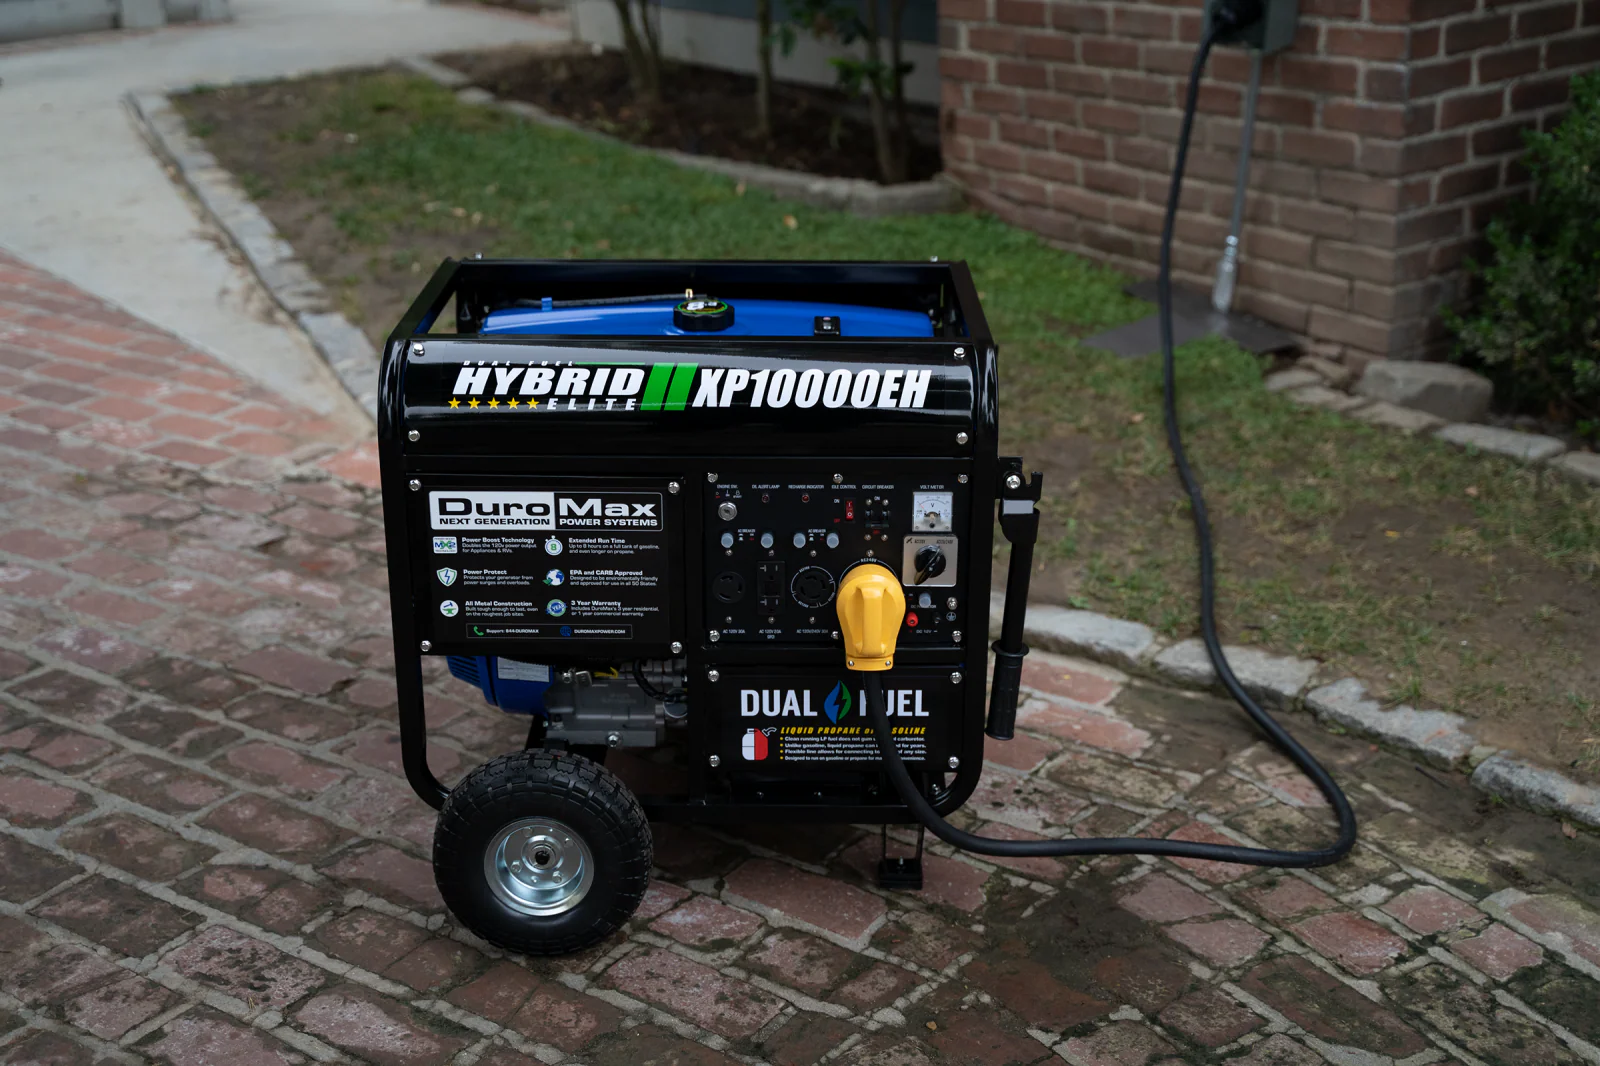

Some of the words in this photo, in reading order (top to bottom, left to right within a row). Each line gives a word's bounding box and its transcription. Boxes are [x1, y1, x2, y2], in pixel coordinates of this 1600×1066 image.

[452, 367, 645, 396] HYBRID
[691, 368, 932, 409] XP10000EH
[546, 397, 637, 411] ELITE
[438, 497, 550, 517] Duro
[558, 497, 656, 517] Max
[439, 518, 470, 526] NEXT
[474, 518, 550, 526] GENERATION
[559, 518, 600, 526] POWER
[603, 518, 658, 526] SYSTEMS
[740, 689, 818, 716] DUAL
[780, 726, 815, 735] LIQUID
[817, 726, 861, 735] PROPANE
[891, 726, 926, 735] SOLINE
